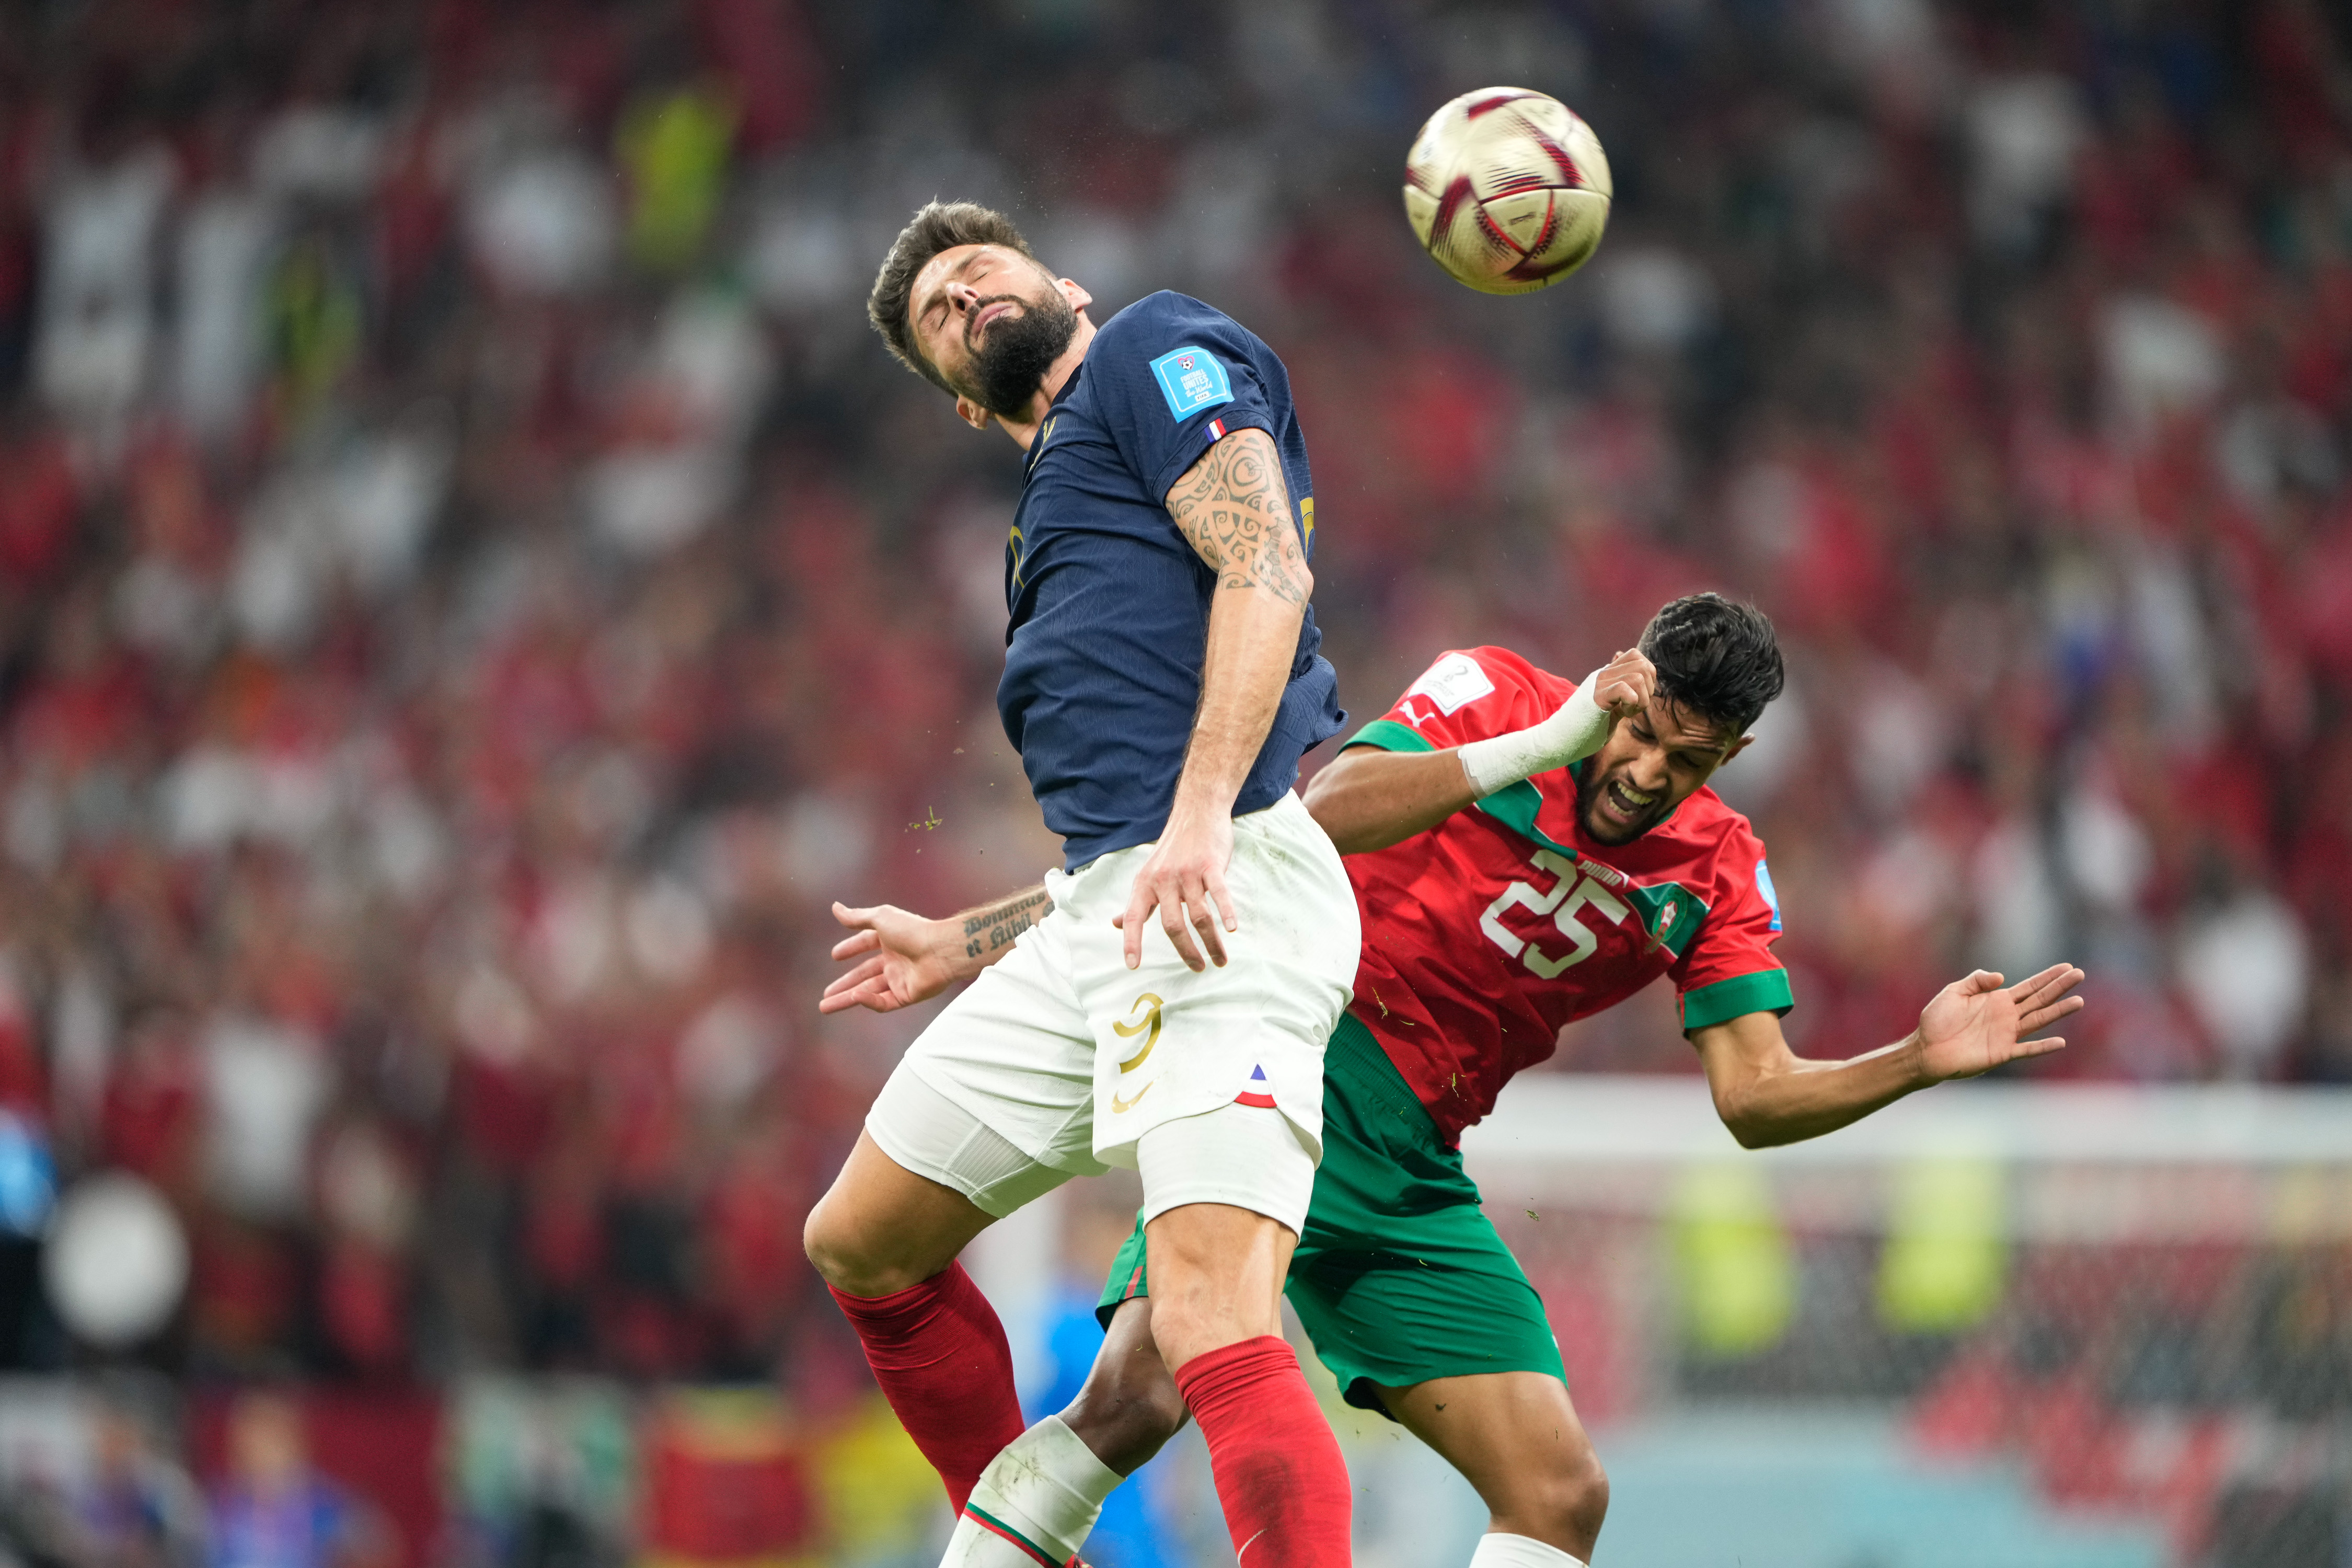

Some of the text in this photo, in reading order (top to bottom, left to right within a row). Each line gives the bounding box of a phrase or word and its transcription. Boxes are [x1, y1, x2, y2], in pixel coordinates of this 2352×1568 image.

[1180, 368, 1206, 383] FOOTBALL
[1183, 374, 1209, 390] UNITES
[1185, 389, 1196, 397] the
[1577, 859, 1623, 886] PUMA
[1479, 849, 1630, 979] 25
[1113, 993, 1165, 1074] 9
